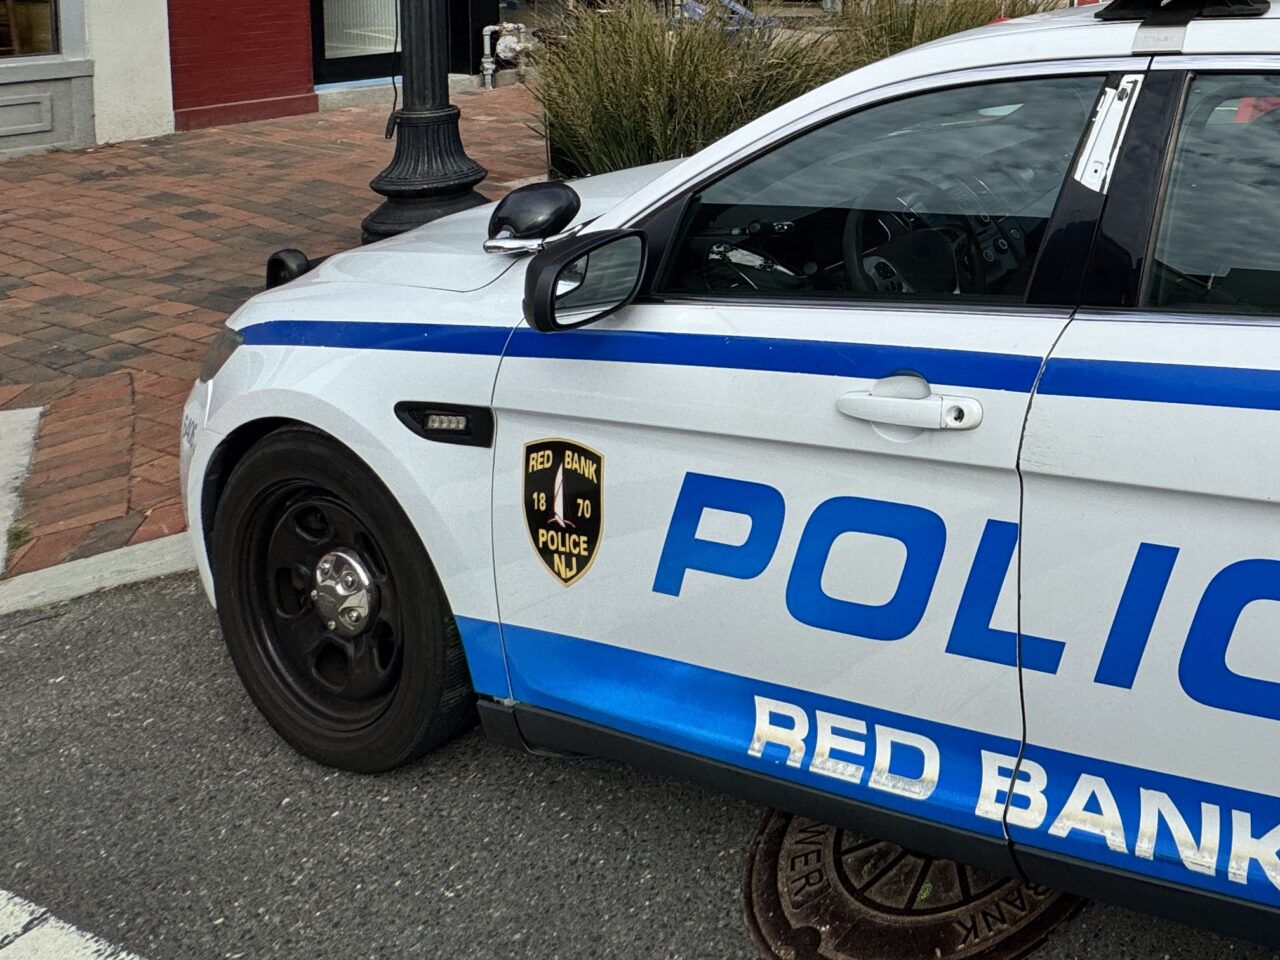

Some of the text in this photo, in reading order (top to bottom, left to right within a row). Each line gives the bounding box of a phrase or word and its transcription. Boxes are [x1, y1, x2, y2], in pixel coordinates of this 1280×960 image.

[529, 450, 597, 484] RED BANK
[532, 492, 592, 519] 18 70
[538, 528, 589, 556] POLICE
[554, 553, 577, 579] NJ
[747, 694, 940, 802] RED
